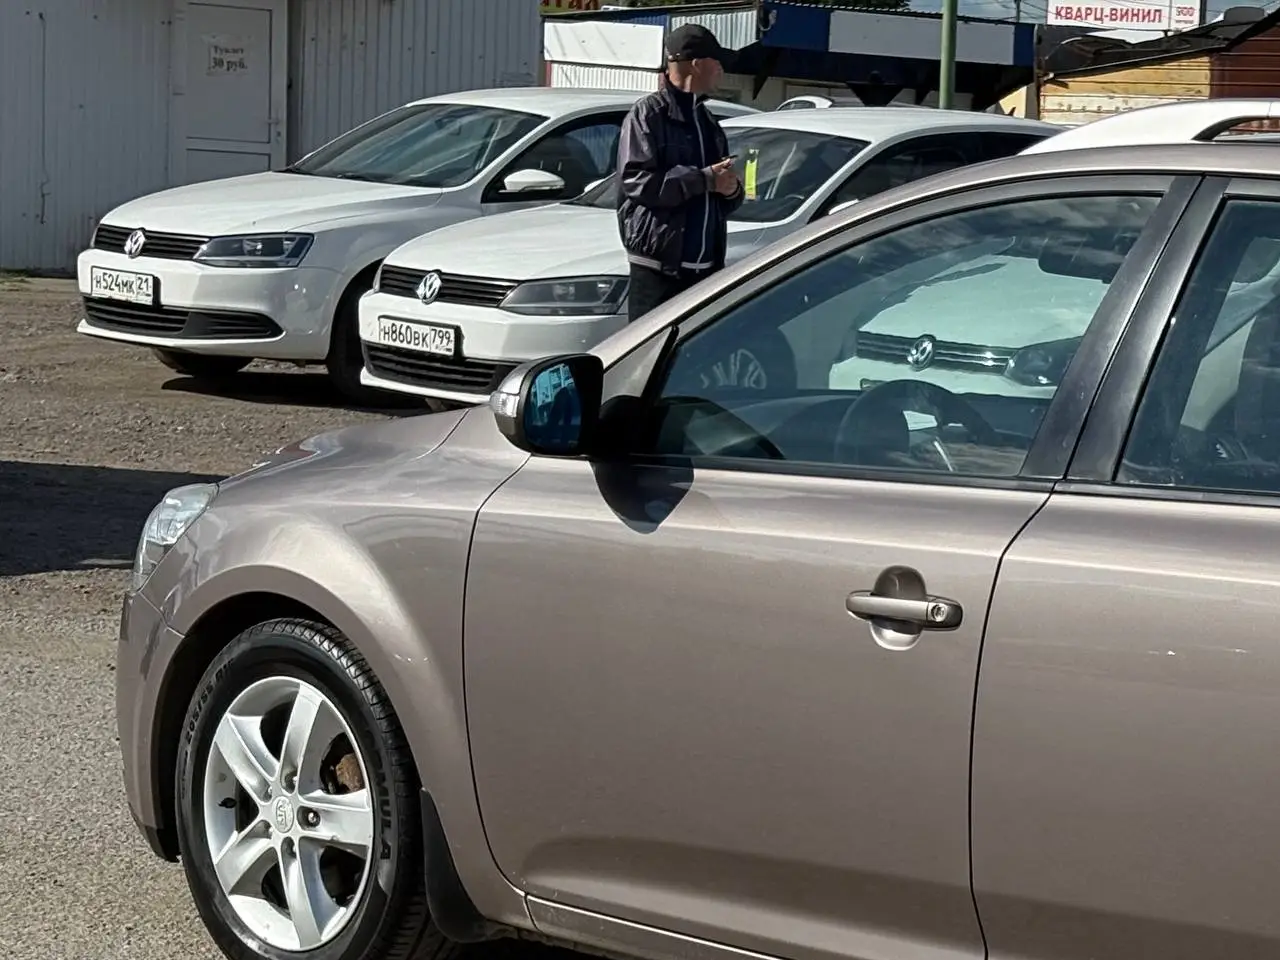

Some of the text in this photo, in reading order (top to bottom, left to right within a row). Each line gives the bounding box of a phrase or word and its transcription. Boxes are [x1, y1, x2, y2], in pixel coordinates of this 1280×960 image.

[1055, 6, 1162, 23] КВАРЦ-ВИНИЛ
[212, 57, 224, 69] 30
[137, 276, 150, 292] 21
[383, 322, 452, 349] Н860ВК 799
